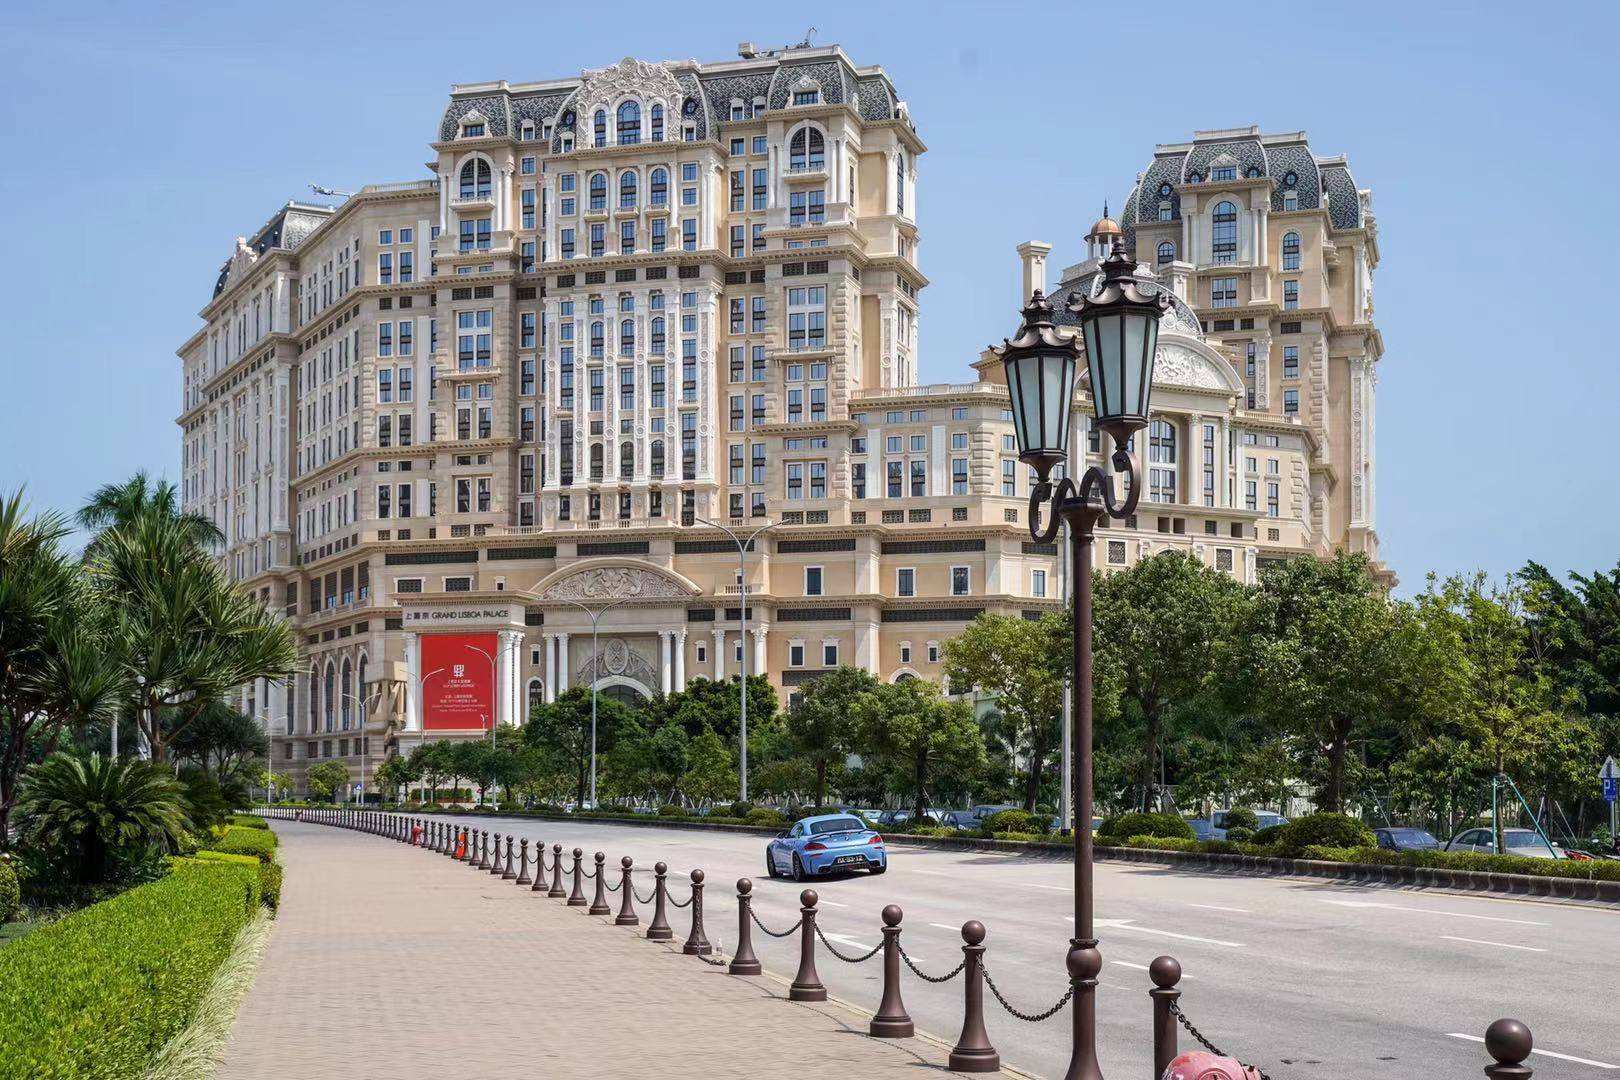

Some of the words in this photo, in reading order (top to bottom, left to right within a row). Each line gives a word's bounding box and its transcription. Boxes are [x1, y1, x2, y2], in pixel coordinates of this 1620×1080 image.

[458, 611, 481, 619] LISBOA
[483, 610, 508, 618] PALACE
[1604, 780, 1610, 795] P
